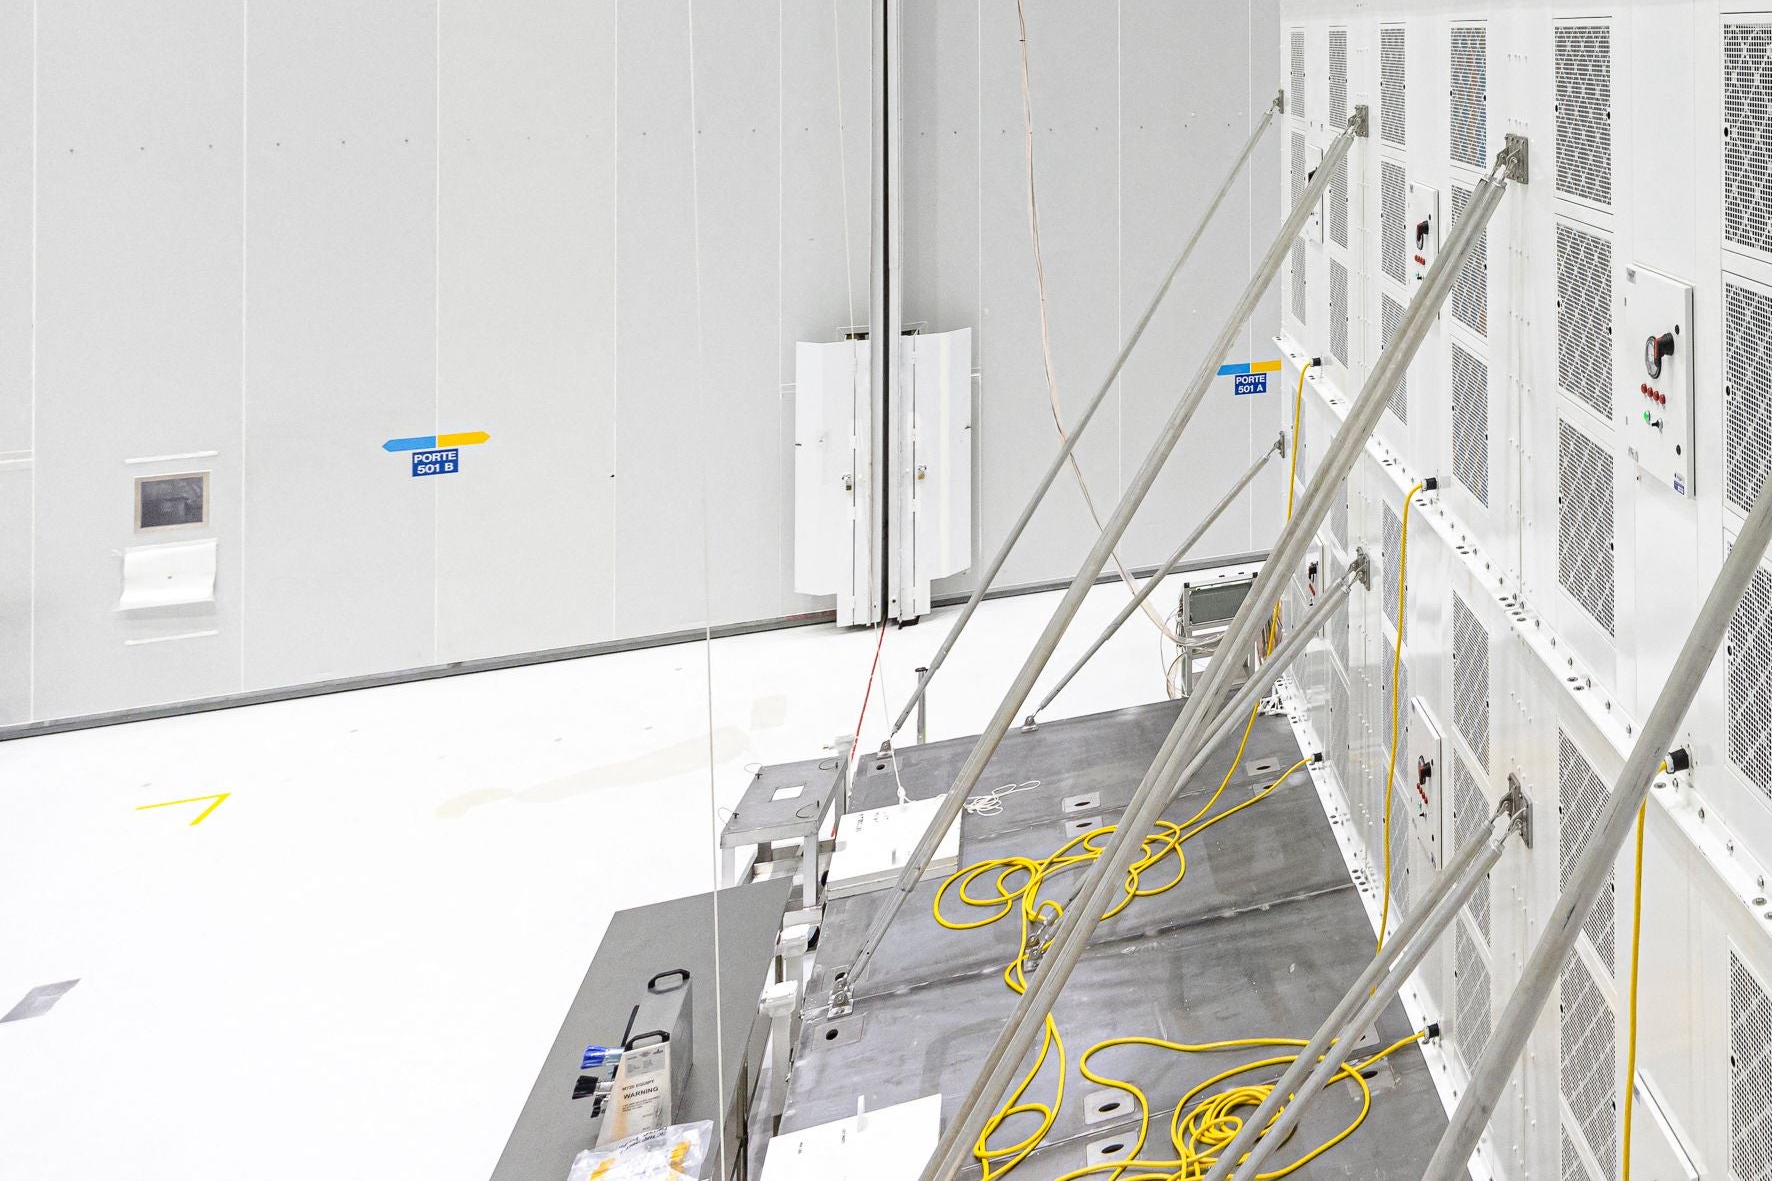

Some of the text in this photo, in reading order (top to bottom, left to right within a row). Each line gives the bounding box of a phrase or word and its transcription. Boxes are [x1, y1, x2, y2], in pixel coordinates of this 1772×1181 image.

[1235, 374, 1265, 385] PORTE
[1238, 383, 1264, 394] 501 A
[413, 450, 457, 464] PORTE
[417, 462, 454, 475] 501 B
[623, 1086, 659, 1100] WARNING
